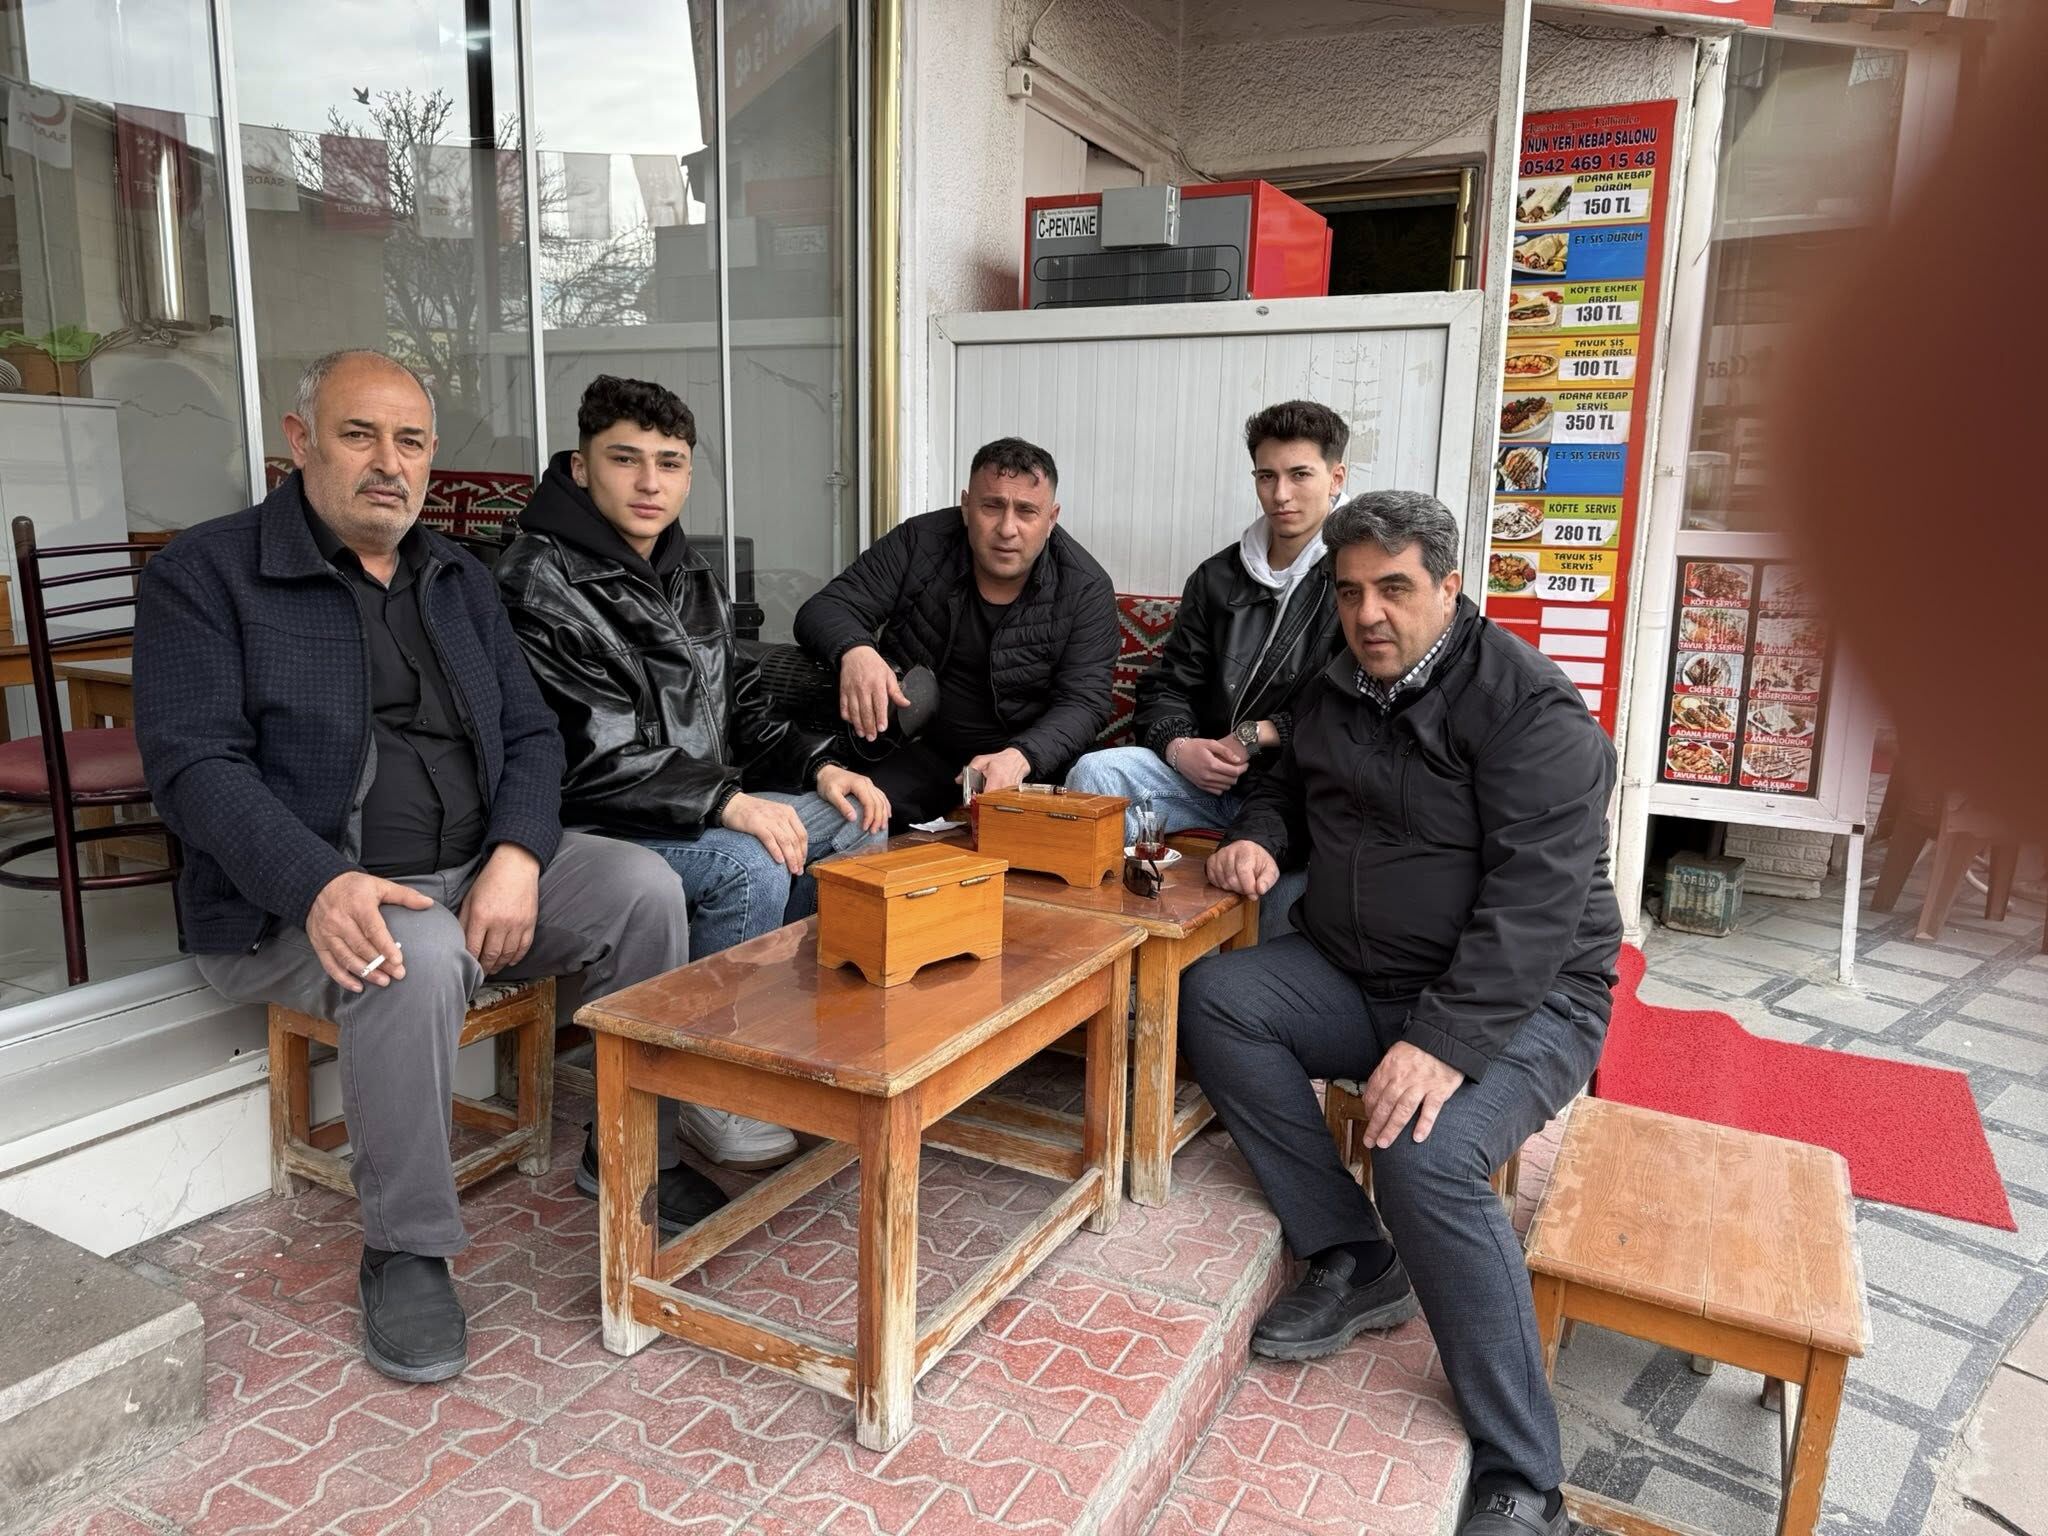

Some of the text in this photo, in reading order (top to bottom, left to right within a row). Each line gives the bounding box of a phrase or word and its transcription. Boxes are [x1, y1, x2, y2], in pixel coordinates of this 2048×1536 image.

[1528, 136, 1549, 154] NUN
[1578, 131, 1613, 149] KEBAP
[1615, 128, 1658, 146] SALONU
[1571, 155, 1602, 171] 469
[1609, 152, 1629, 168] 15
[1634, 150, 1656, 167] 48
[1577, 170, 1652, 183] ADANA KEBAP
[1594, 182, 1632, 192] DÜRÜM
[1584, 197, 1631, 215] 150 TL
[1575, 235, 1586, 244] ET
[1605, 284, 1637, 293] EKMEK
[1588, 295, 1617, 303] ARASI
[1576, 305, 1623, 322] 130 TL
[1610, 338, 1624, 348] ŞİŞ
[1565, 348, 1632, 357] EKMEK ARASI
[1573, 360, 1619, 376] 100 TL
[1559, 391, 1628, 400] ADANA KEBAP
[1565, 414, 1615, 430] 350 TL
[1555, 451, 1566, 460] ET
[1554, 525, 1602, 541] 280 TL
[1554, 553, 1585, 561] TAVUK
[1547, 575, 1595, 592] 230 TL
[1679, 641, 1703, 649] TAVUK
[1675, 730, 1701, 738] ADANA
[1673, 771, 1723, 782] TAVUK KANAT
[1770, 781, 1795, 790] KEBAP
